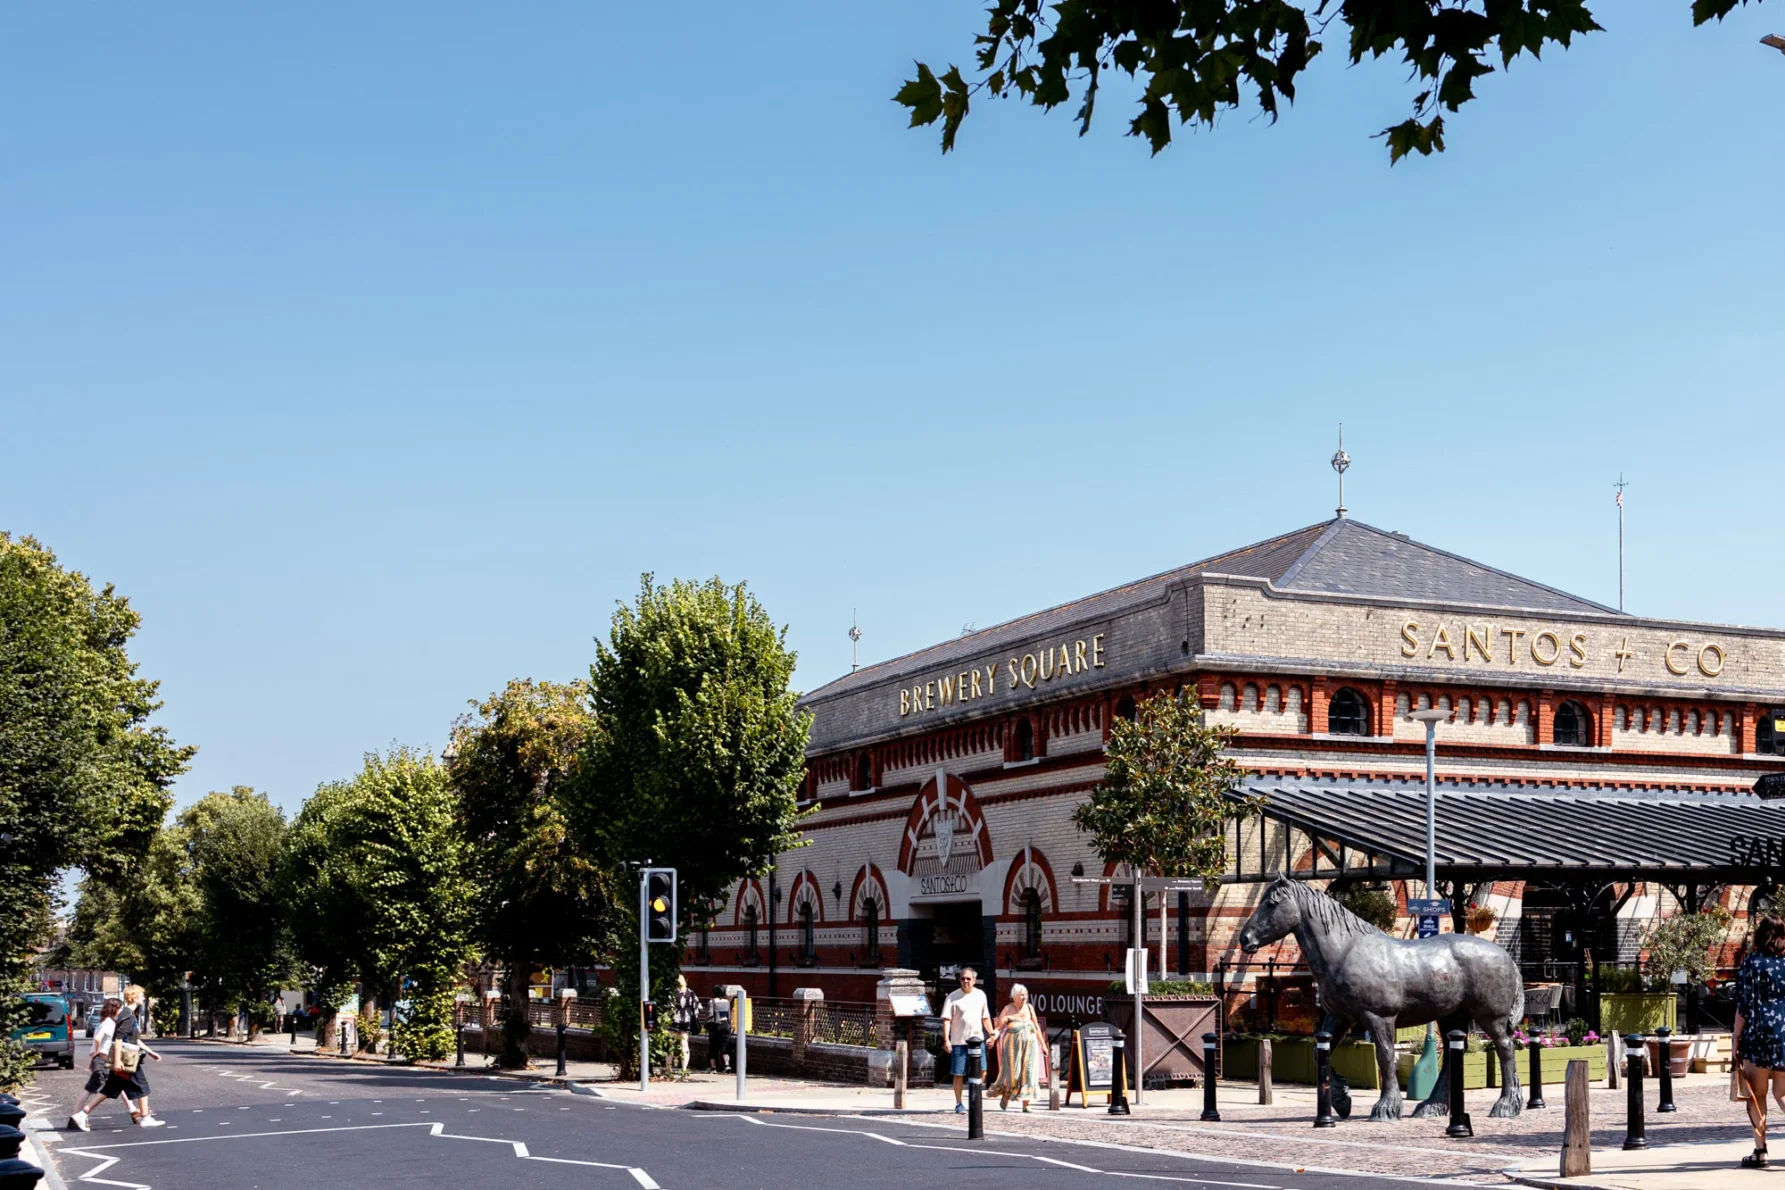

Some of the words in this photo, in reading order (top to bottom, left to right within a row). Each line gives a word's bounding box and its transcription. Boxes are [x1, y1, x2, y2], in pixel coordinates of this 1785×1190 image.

[1401, 620, 1588, 667] SANTOS
[1664, 640, 1727, 676] CO
[900, 662, 999, 716] BREWERY
[1008, 633, 1106, 691] SQUARE
[921, 875, 967, 894] SANTOS+CO
[1051, 994, 1102, 1014] LOUNGE
